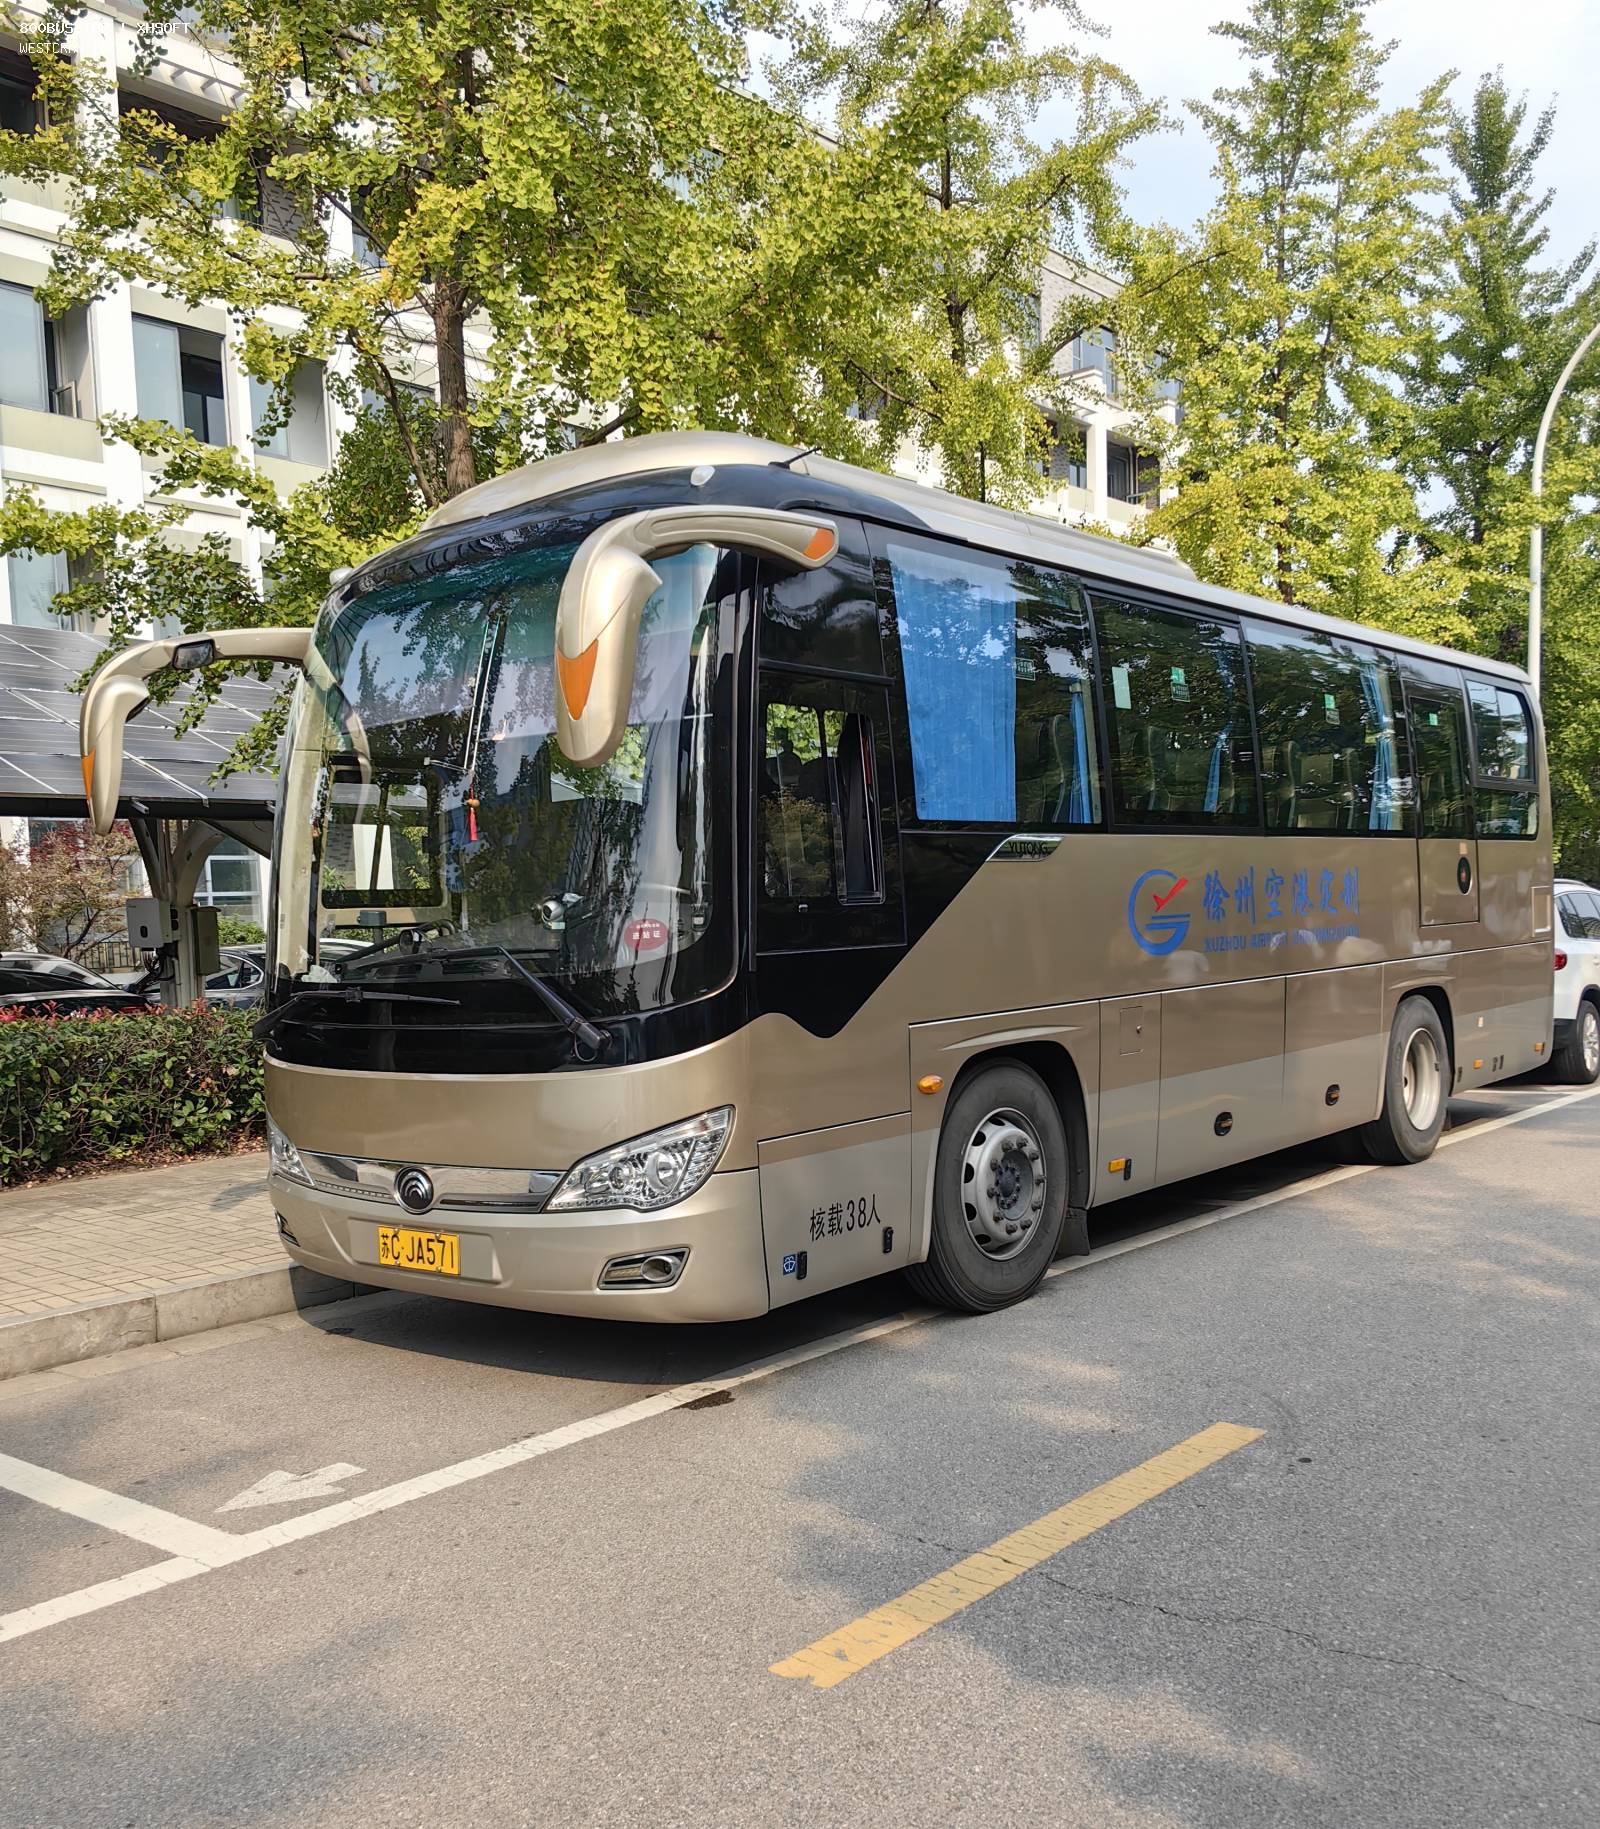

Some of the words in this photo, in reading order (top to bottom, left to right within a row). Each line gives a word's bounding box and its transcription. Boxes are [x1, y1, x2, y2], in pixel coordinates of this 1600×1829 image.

[1009, 841, 1048, 855] YUTONG
[1204, 935, 1247, 952] XUZHOU
[809, 1193, 881, 1242] 核载38人
